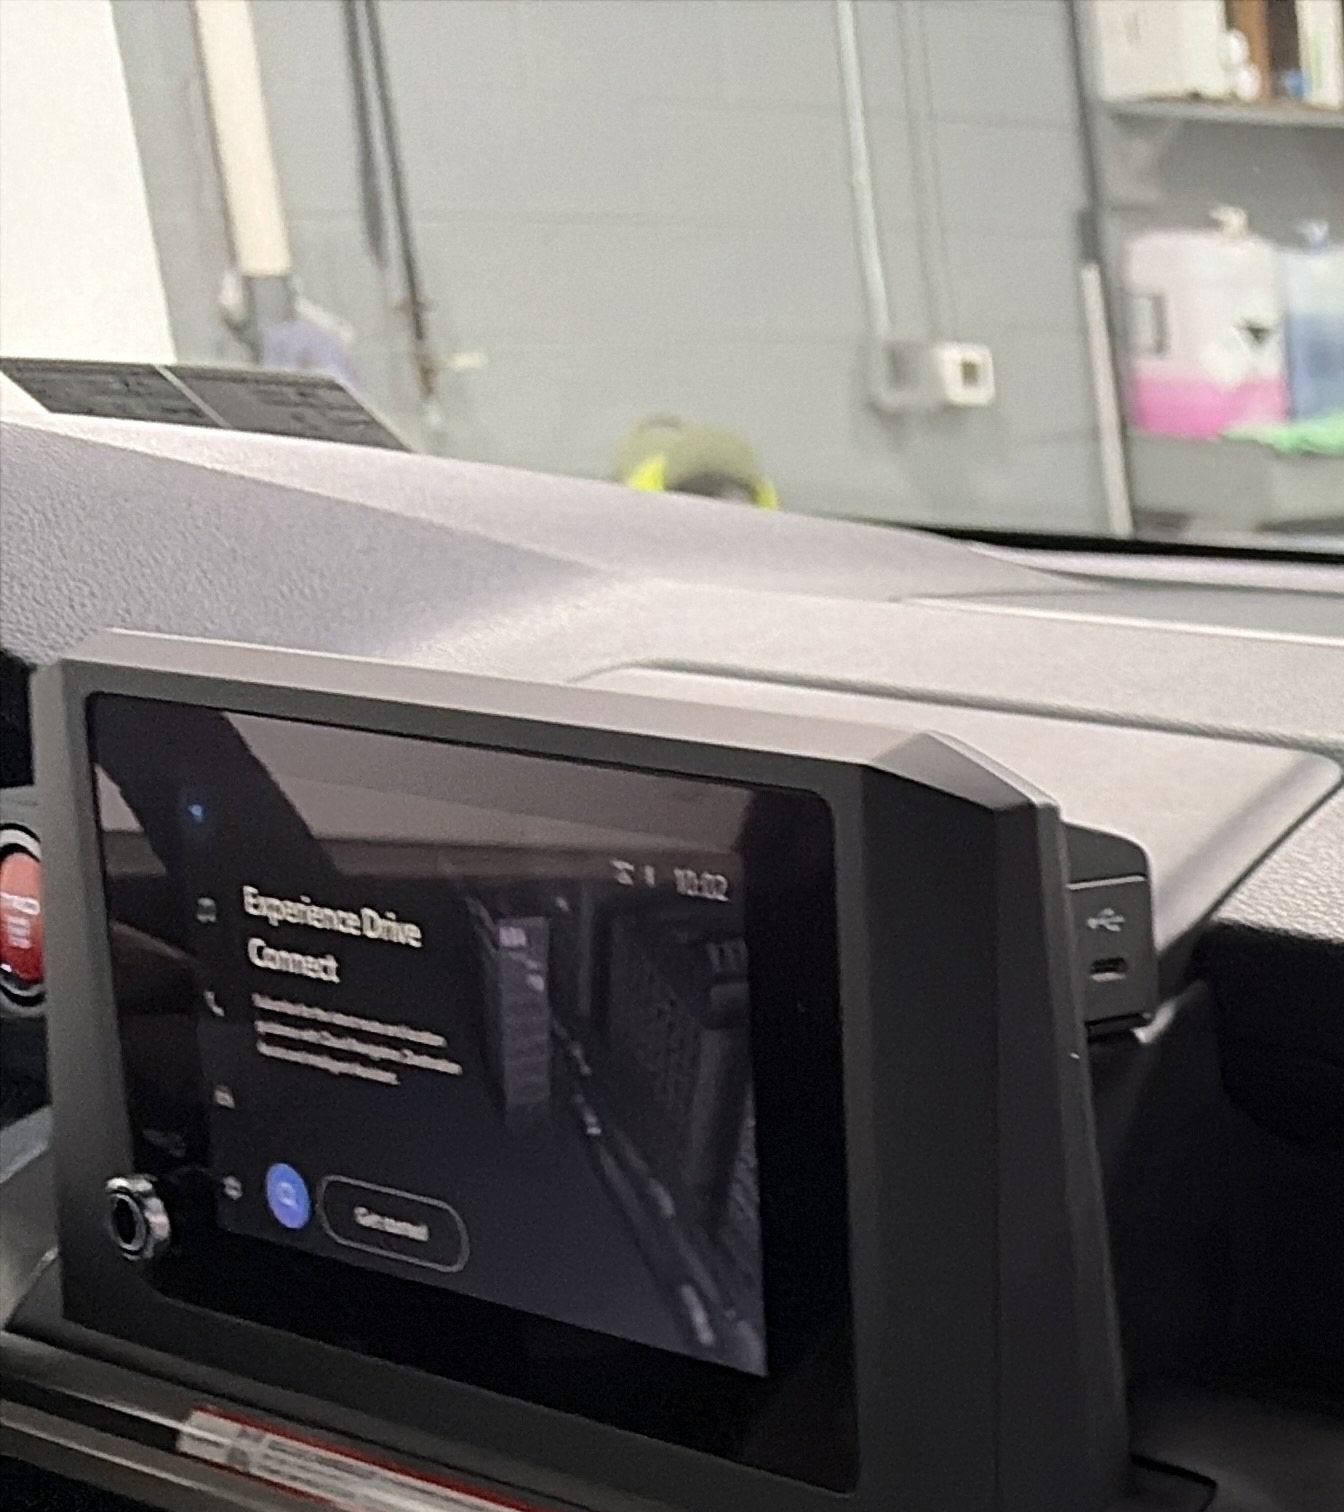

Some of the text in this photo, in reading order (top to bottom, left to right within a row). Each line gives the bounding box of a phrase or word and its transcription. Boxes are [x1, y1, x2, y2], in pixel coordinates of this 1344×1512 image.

[243, 885, 423, 948] Experience Drive
[247, 937, 341, 984] Connect
